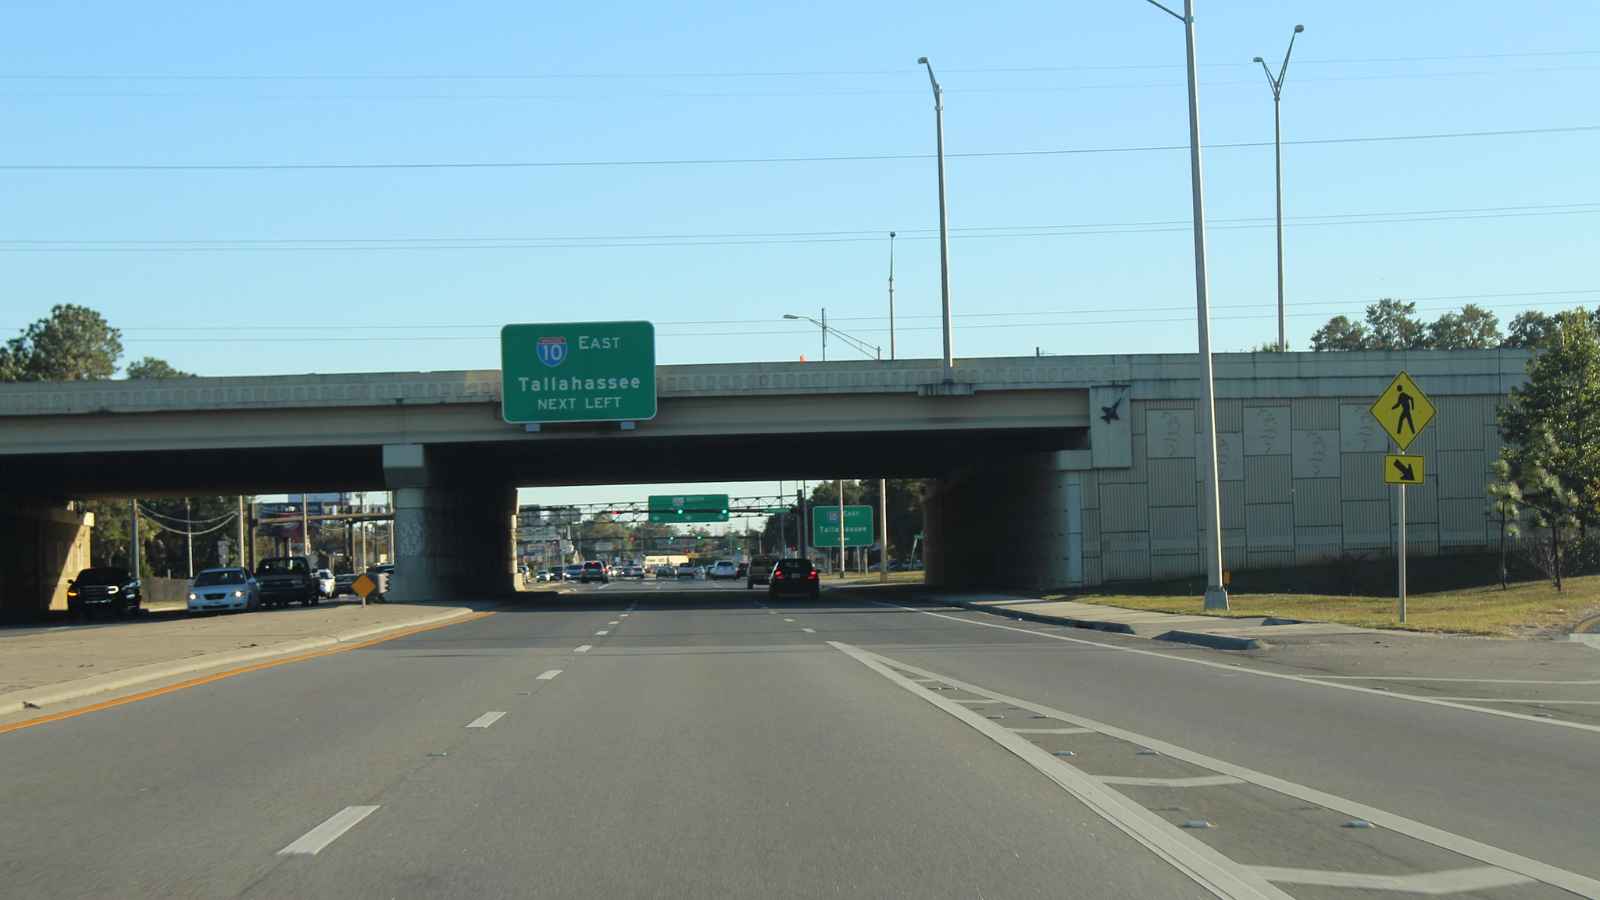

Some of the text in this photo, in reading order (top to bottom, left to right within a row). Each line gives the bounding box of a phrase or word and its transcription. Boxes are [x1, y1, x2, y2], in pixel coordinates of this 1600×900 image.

[543, 336, 621, 361] 10 EAST
[518, 376, 641, 392] Tallahassee
[537, 396, 622, 410] NEXT LEFT
[819, 525, 867, 534] Tallaassee
